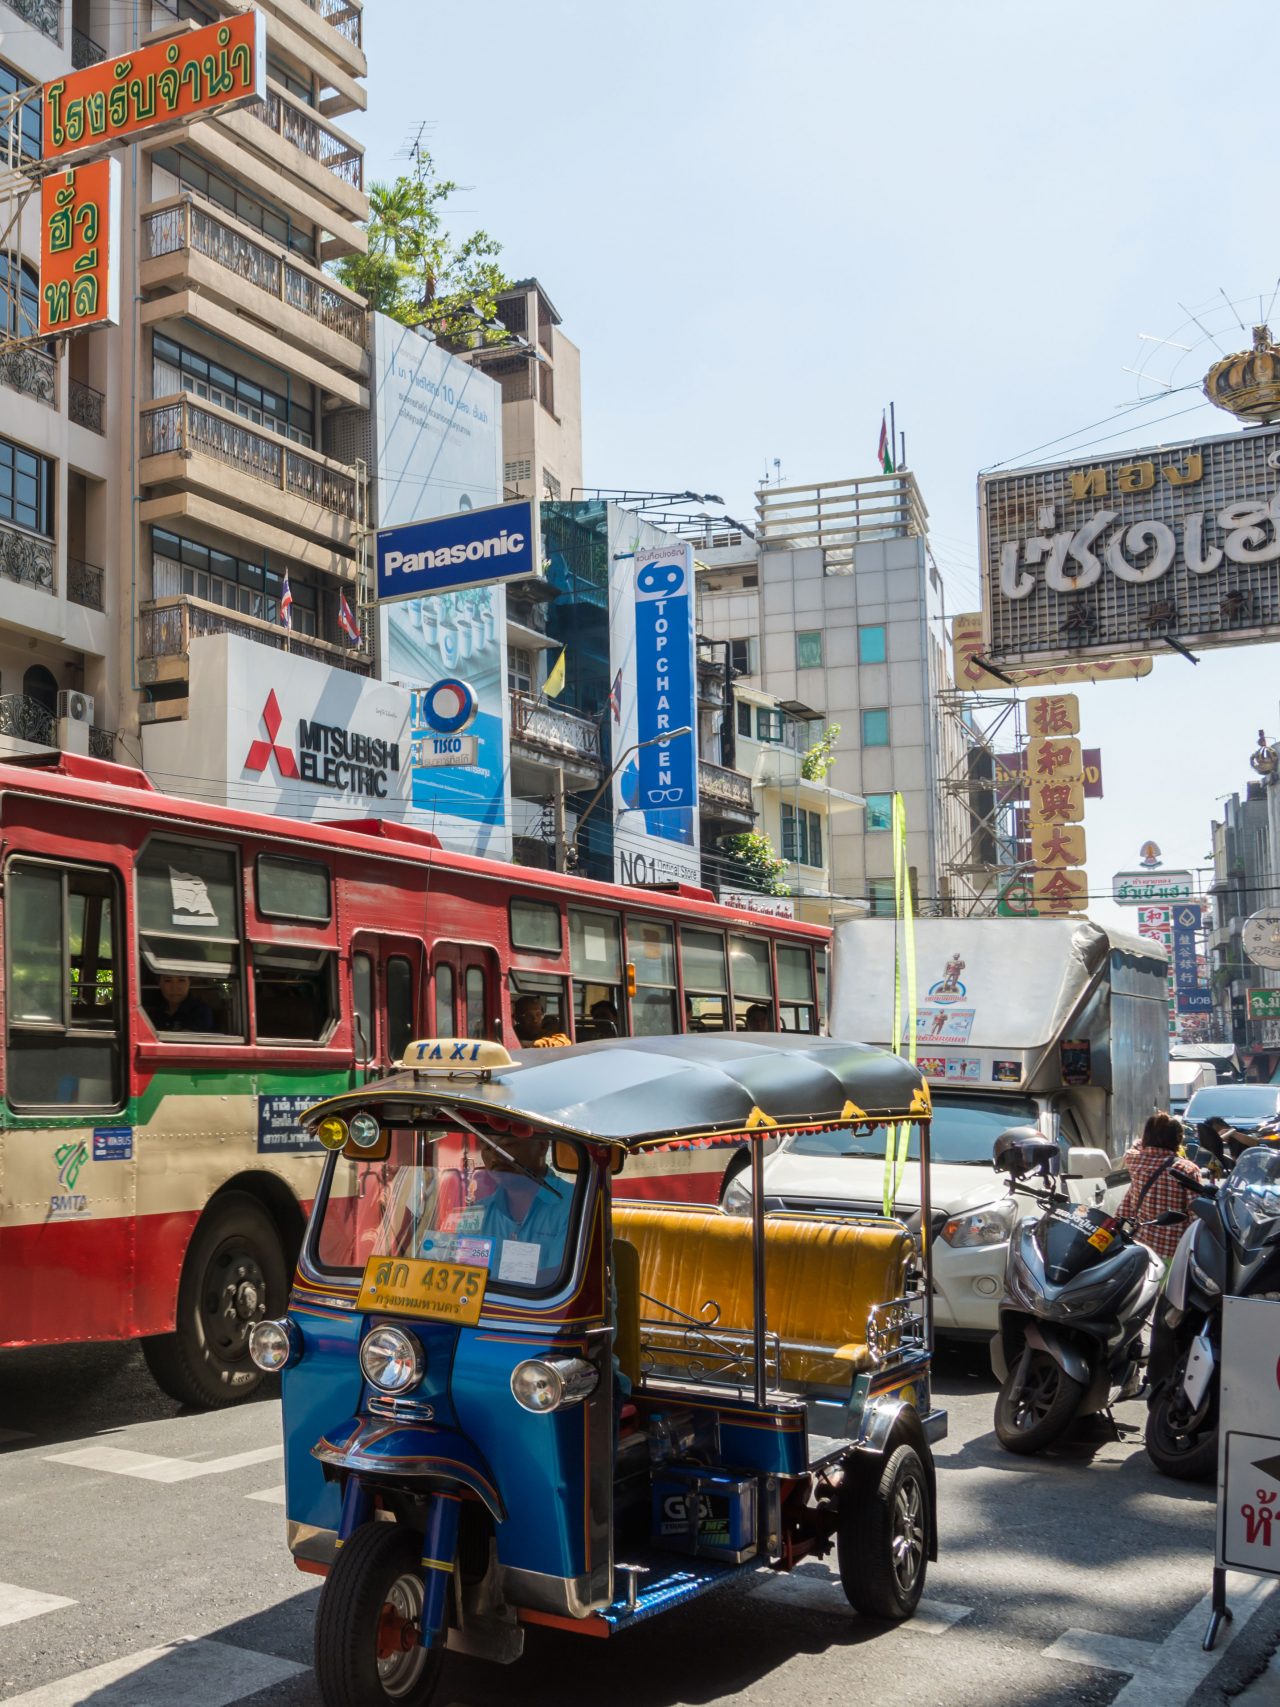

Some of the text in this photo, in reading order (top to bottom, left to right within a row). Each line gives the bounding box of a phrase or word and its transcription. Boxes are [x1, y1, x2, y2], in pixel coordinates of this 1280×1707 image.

[47, 26, 251, 147] โรงรับจำนำ
[48, 168, 99, 254] ฮั่ว
[44, 247, 99, 325] หลี
[442, 384, 455, 406] 10
[1070, 454, 1204, 500] ทอง
[384, 530, 524, 577] Panasonic
[655, 601, 669, 652] TOP
[299, 718, 399, 772] MITSUBISHI
[433, 738, 461, 754] TISCO
[299, 751, 388, 798] ELECTRIC
[1030, 697, 1082, 910] 振和興大金
[1189, 996, 1211, 1005] UOB
[416, 1043, 481, 1061] TAXI
[375, 1261, 481, 1297] สก 4375
[375, 1294, 461, 1314] กรุงเทพมหานคร
[1240, 1489, 1280, 1547] ห้
